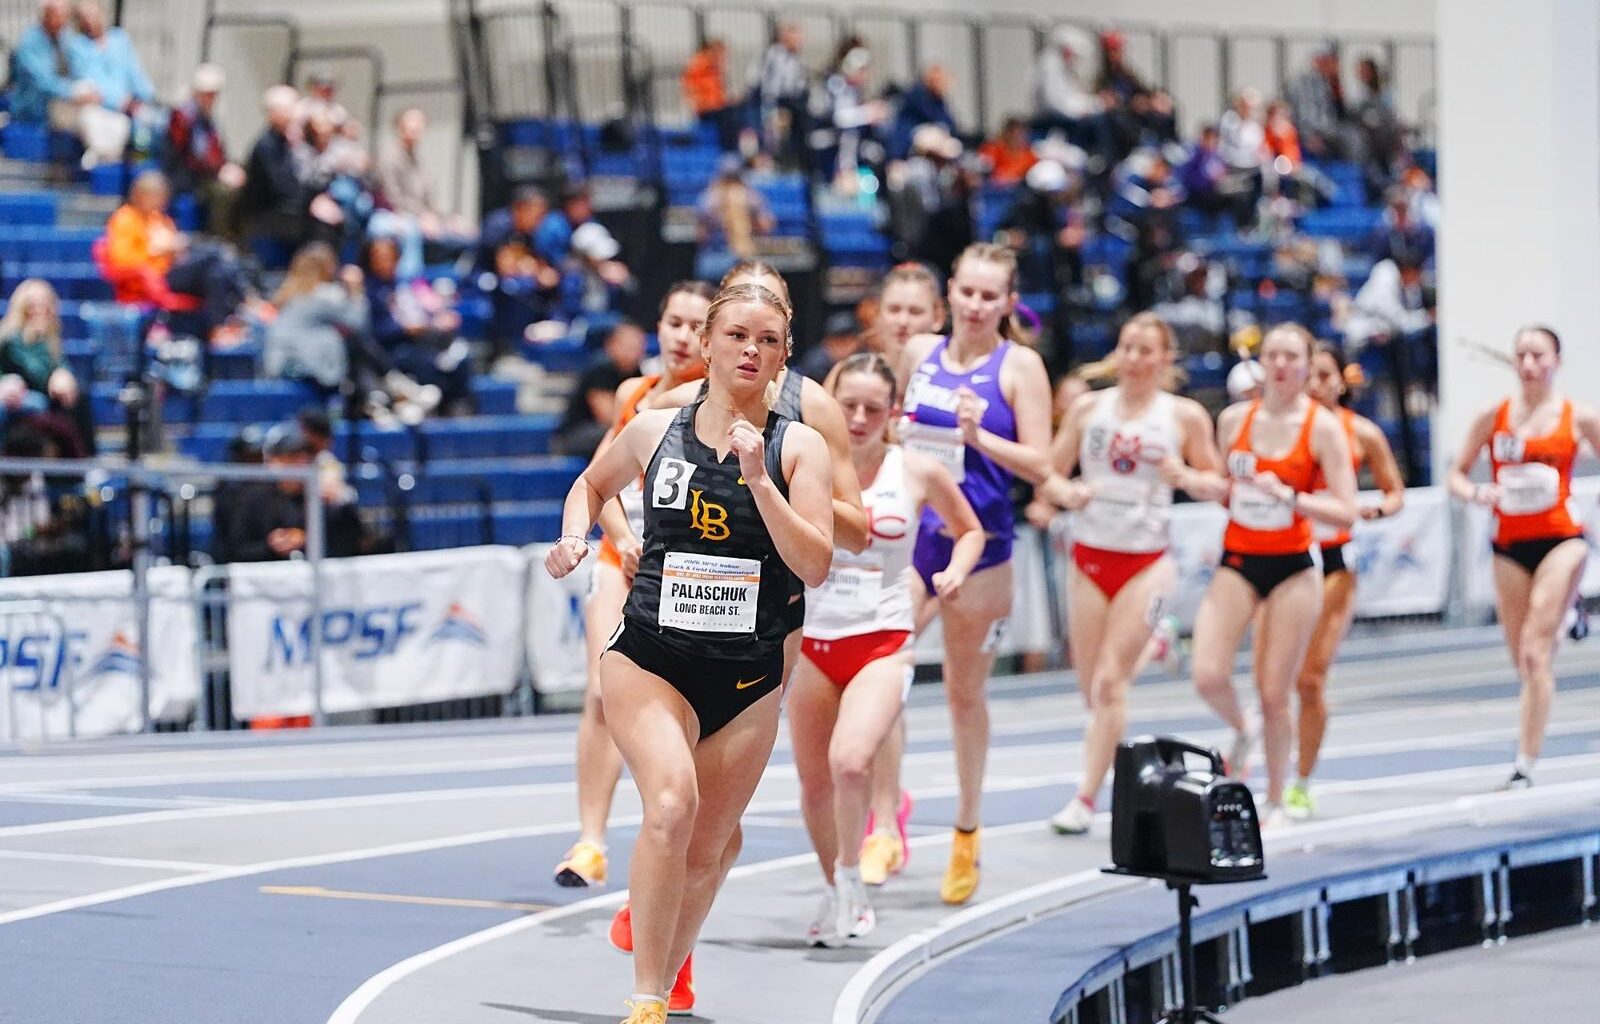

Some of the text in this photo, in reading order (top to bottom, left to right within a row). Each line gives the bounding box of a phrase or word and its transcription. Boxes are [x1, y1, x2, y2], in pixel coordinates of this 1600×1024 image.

[658, 462, 685, 505] 3
[689, 489, 731, 540] LB
[708, 568, 756, 576] Championships
[671, 582, 748, 602] PALASCHUK
[674, 602, 741, 616] LONG BEACH ST.
[265, 602, 422, 671] MPSF
